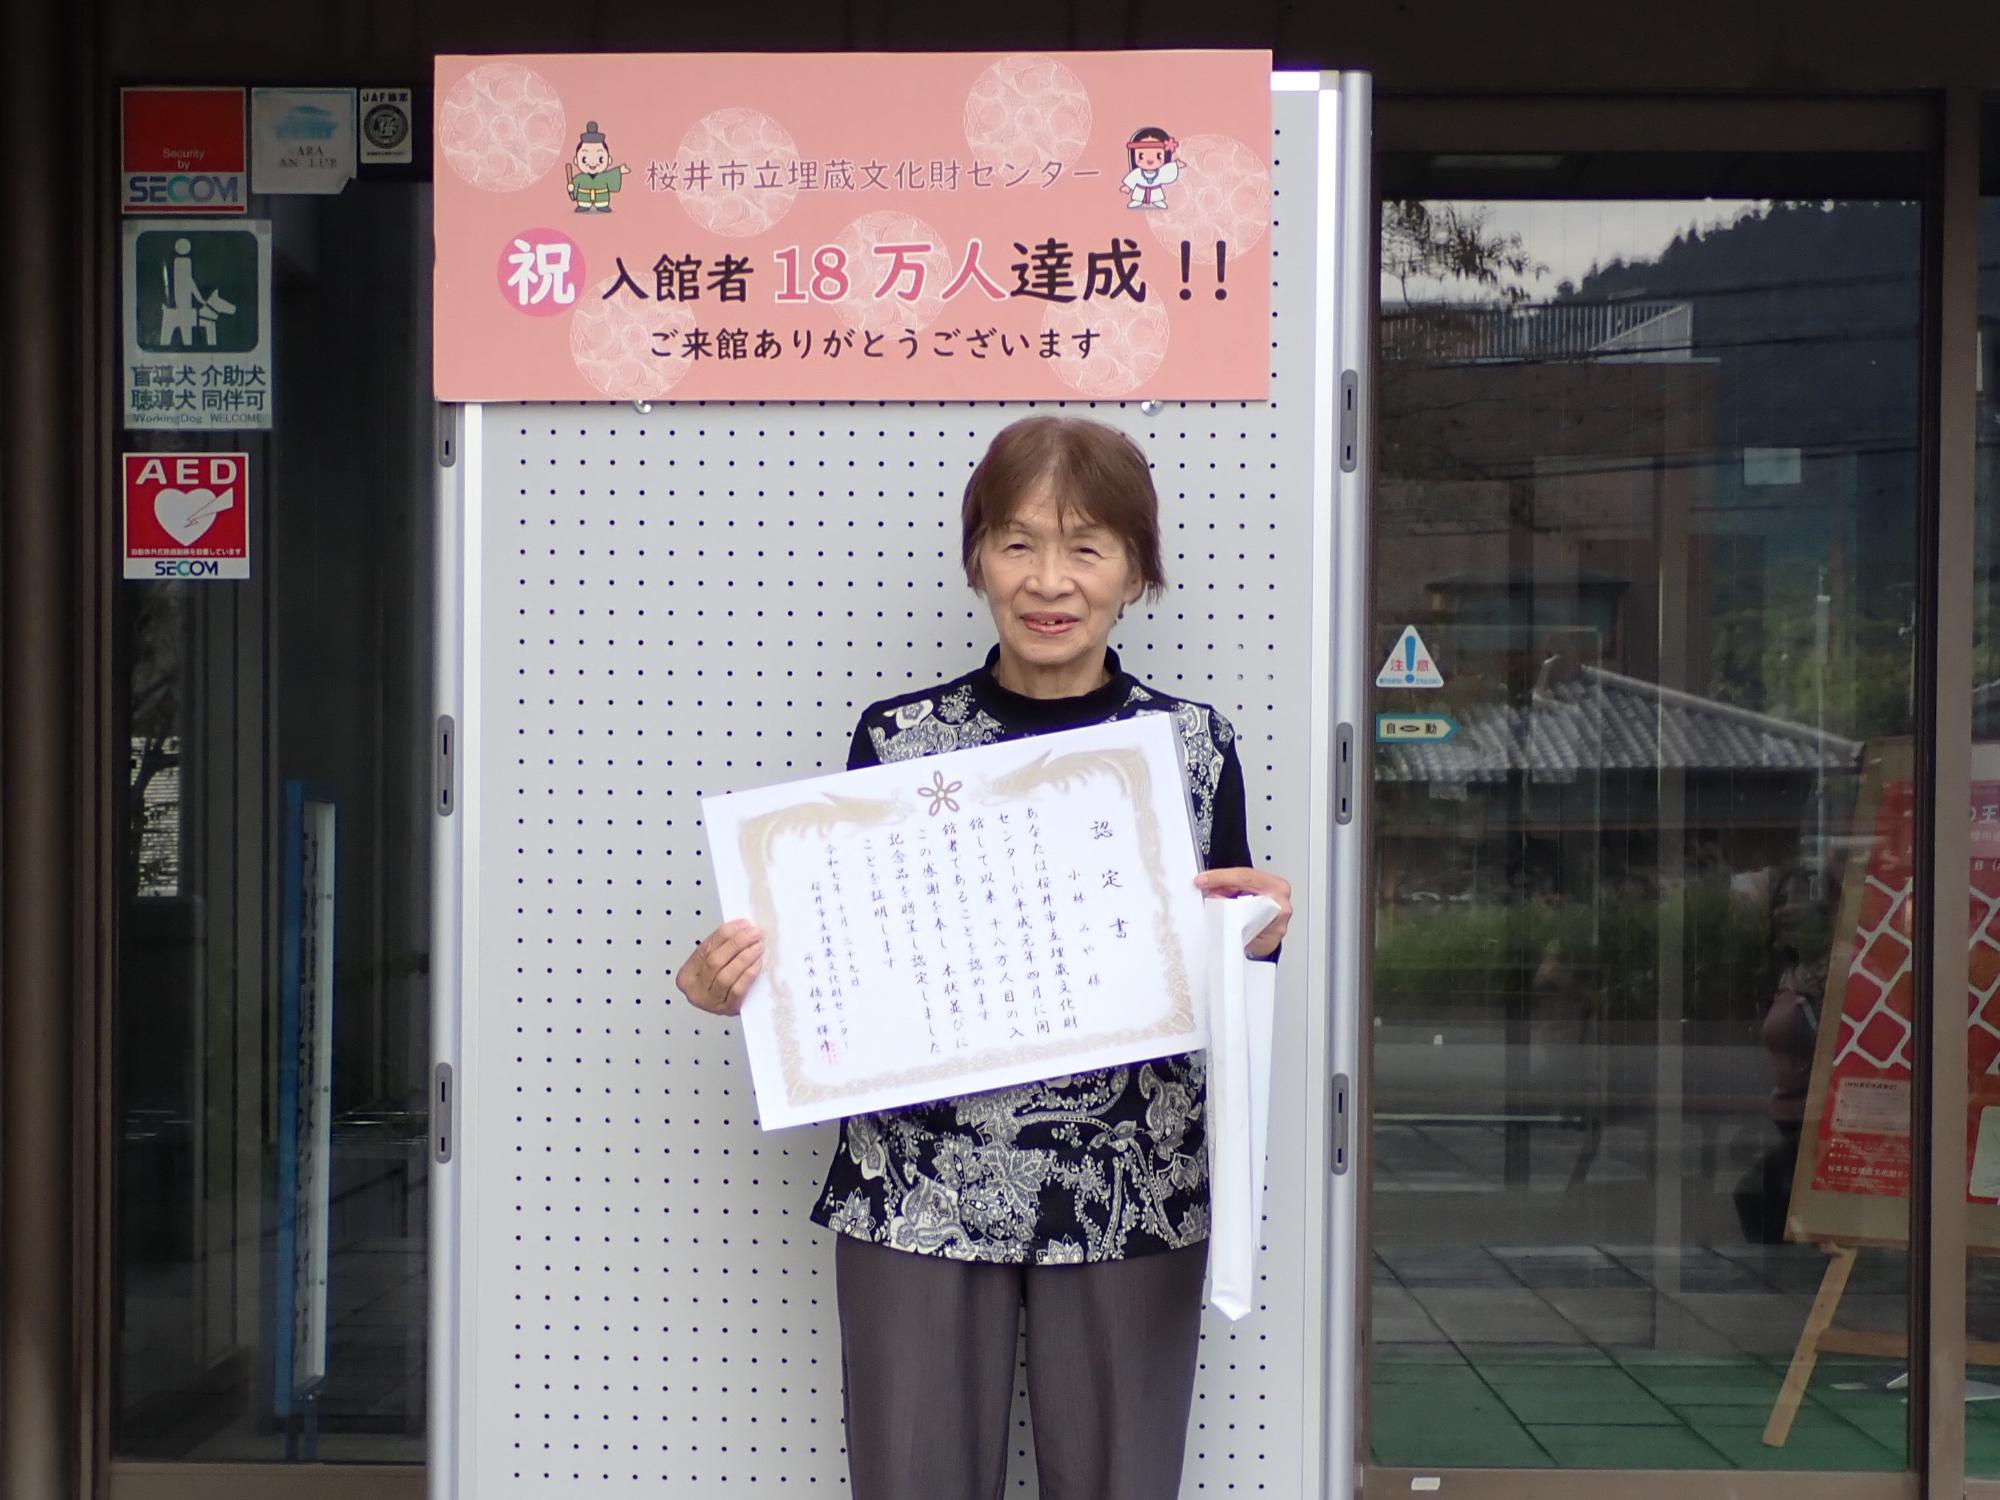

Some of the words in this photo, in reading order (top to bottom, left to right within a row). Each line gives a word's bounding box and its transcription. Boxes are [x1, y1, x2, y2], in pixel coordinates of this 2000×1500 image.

[162, 147, 205, 159] Security
[177, 160, 190, 170] by
[645, 160, 1101, 192] 桜井市立埋蔵文化財センター
[129, 176, 238, 202] SECOM
[507, 239, 576, 306] 祝
[650, 328, 1101, 360] ご来館ありがとうございます
[130, 364, 196, 387] 盲導犬
[201, 364, 266, 387] 介助犬
[131, 389, 196, 411] 聴導犬
[202, 389, 266, 411] 同伴可
[210, 413, 263, 424] WELCOME
[135, 458, 237, 485] AED
[155, 561, 218, 576] SECOM
[1089, 821, 1129, 939] 認定書
